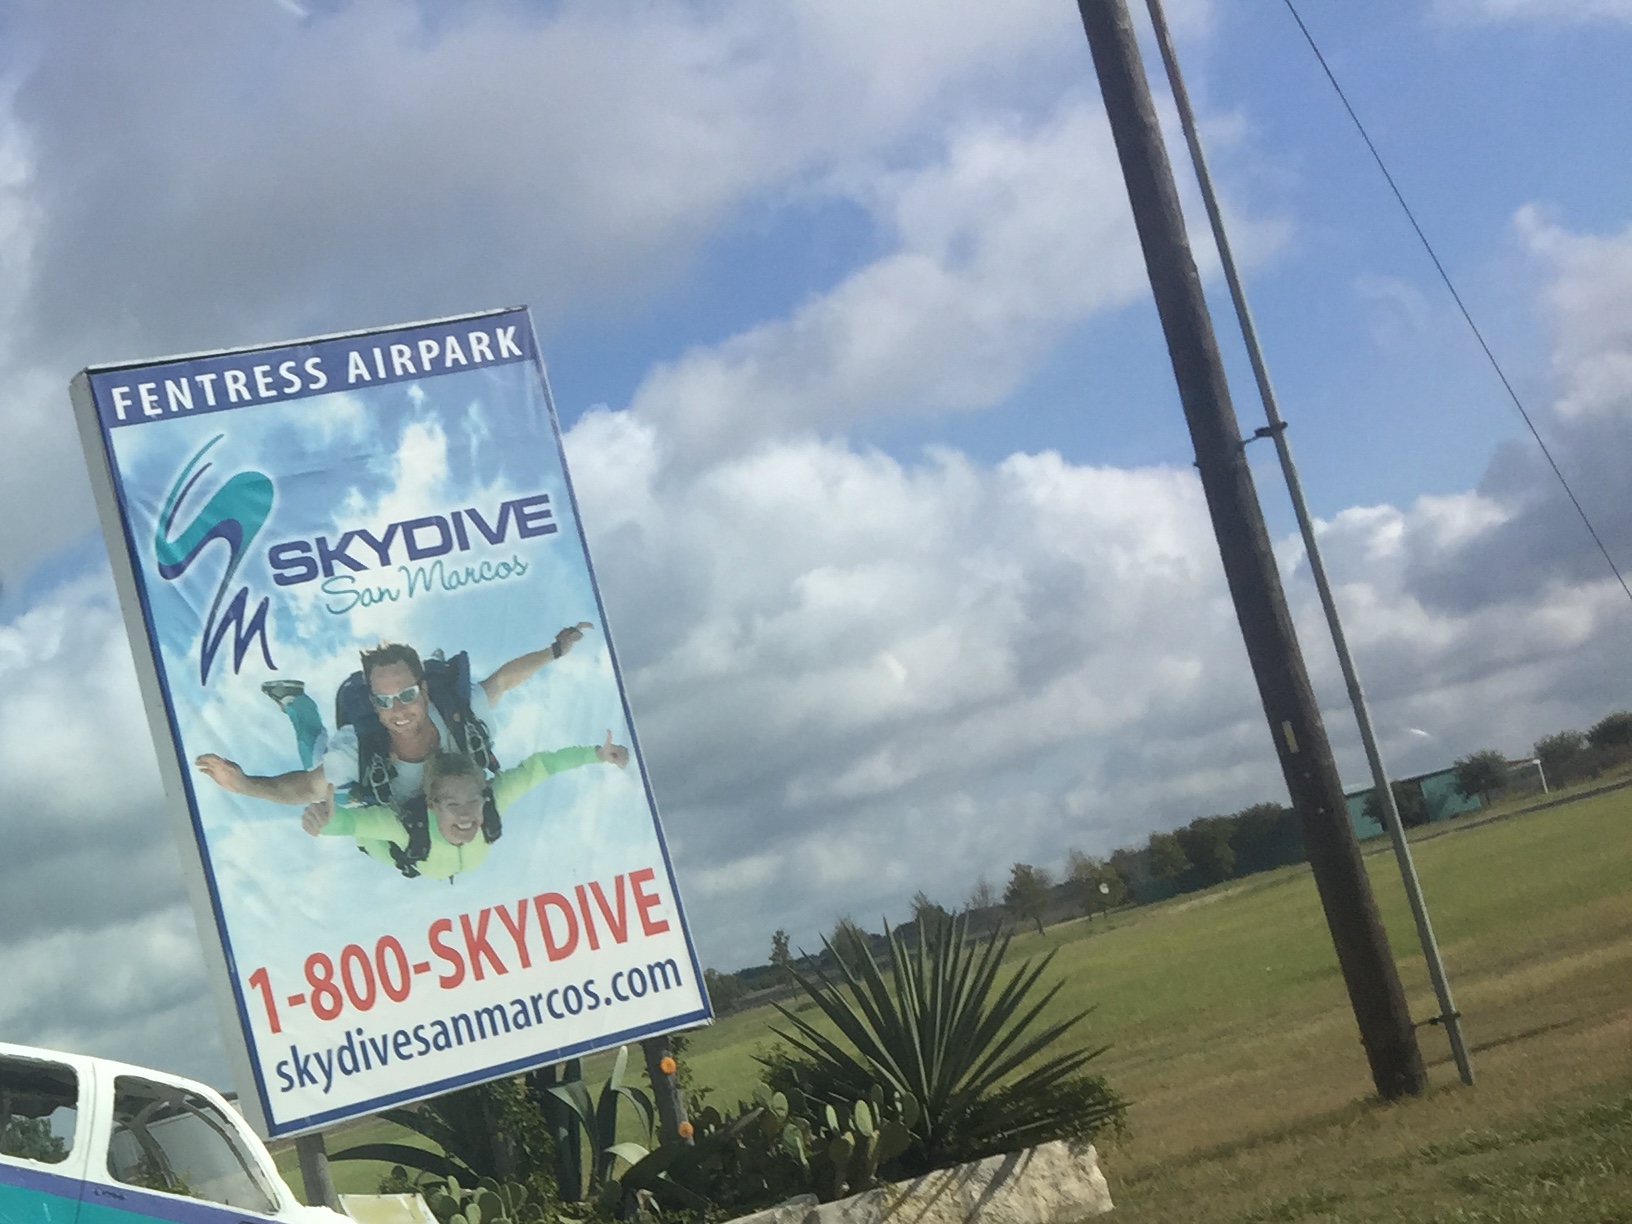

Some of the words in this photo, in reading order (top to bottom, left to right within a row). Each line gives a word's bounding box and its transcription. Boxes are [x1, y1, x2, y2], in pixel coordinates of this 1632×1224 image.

[111, 357, 329, 421] FENTRESS
[347, 325, 523, 384] AIRPARK
[270, 494, 558, 587] SKYDIVE
[321, 574, 400, 615] San
[398, 554, 530, 602] Marcos
[249, 867, 670, 1034] 1-800-SKYDIVE
[276, 957, 683, 1094] skydivesanmarcos.com
